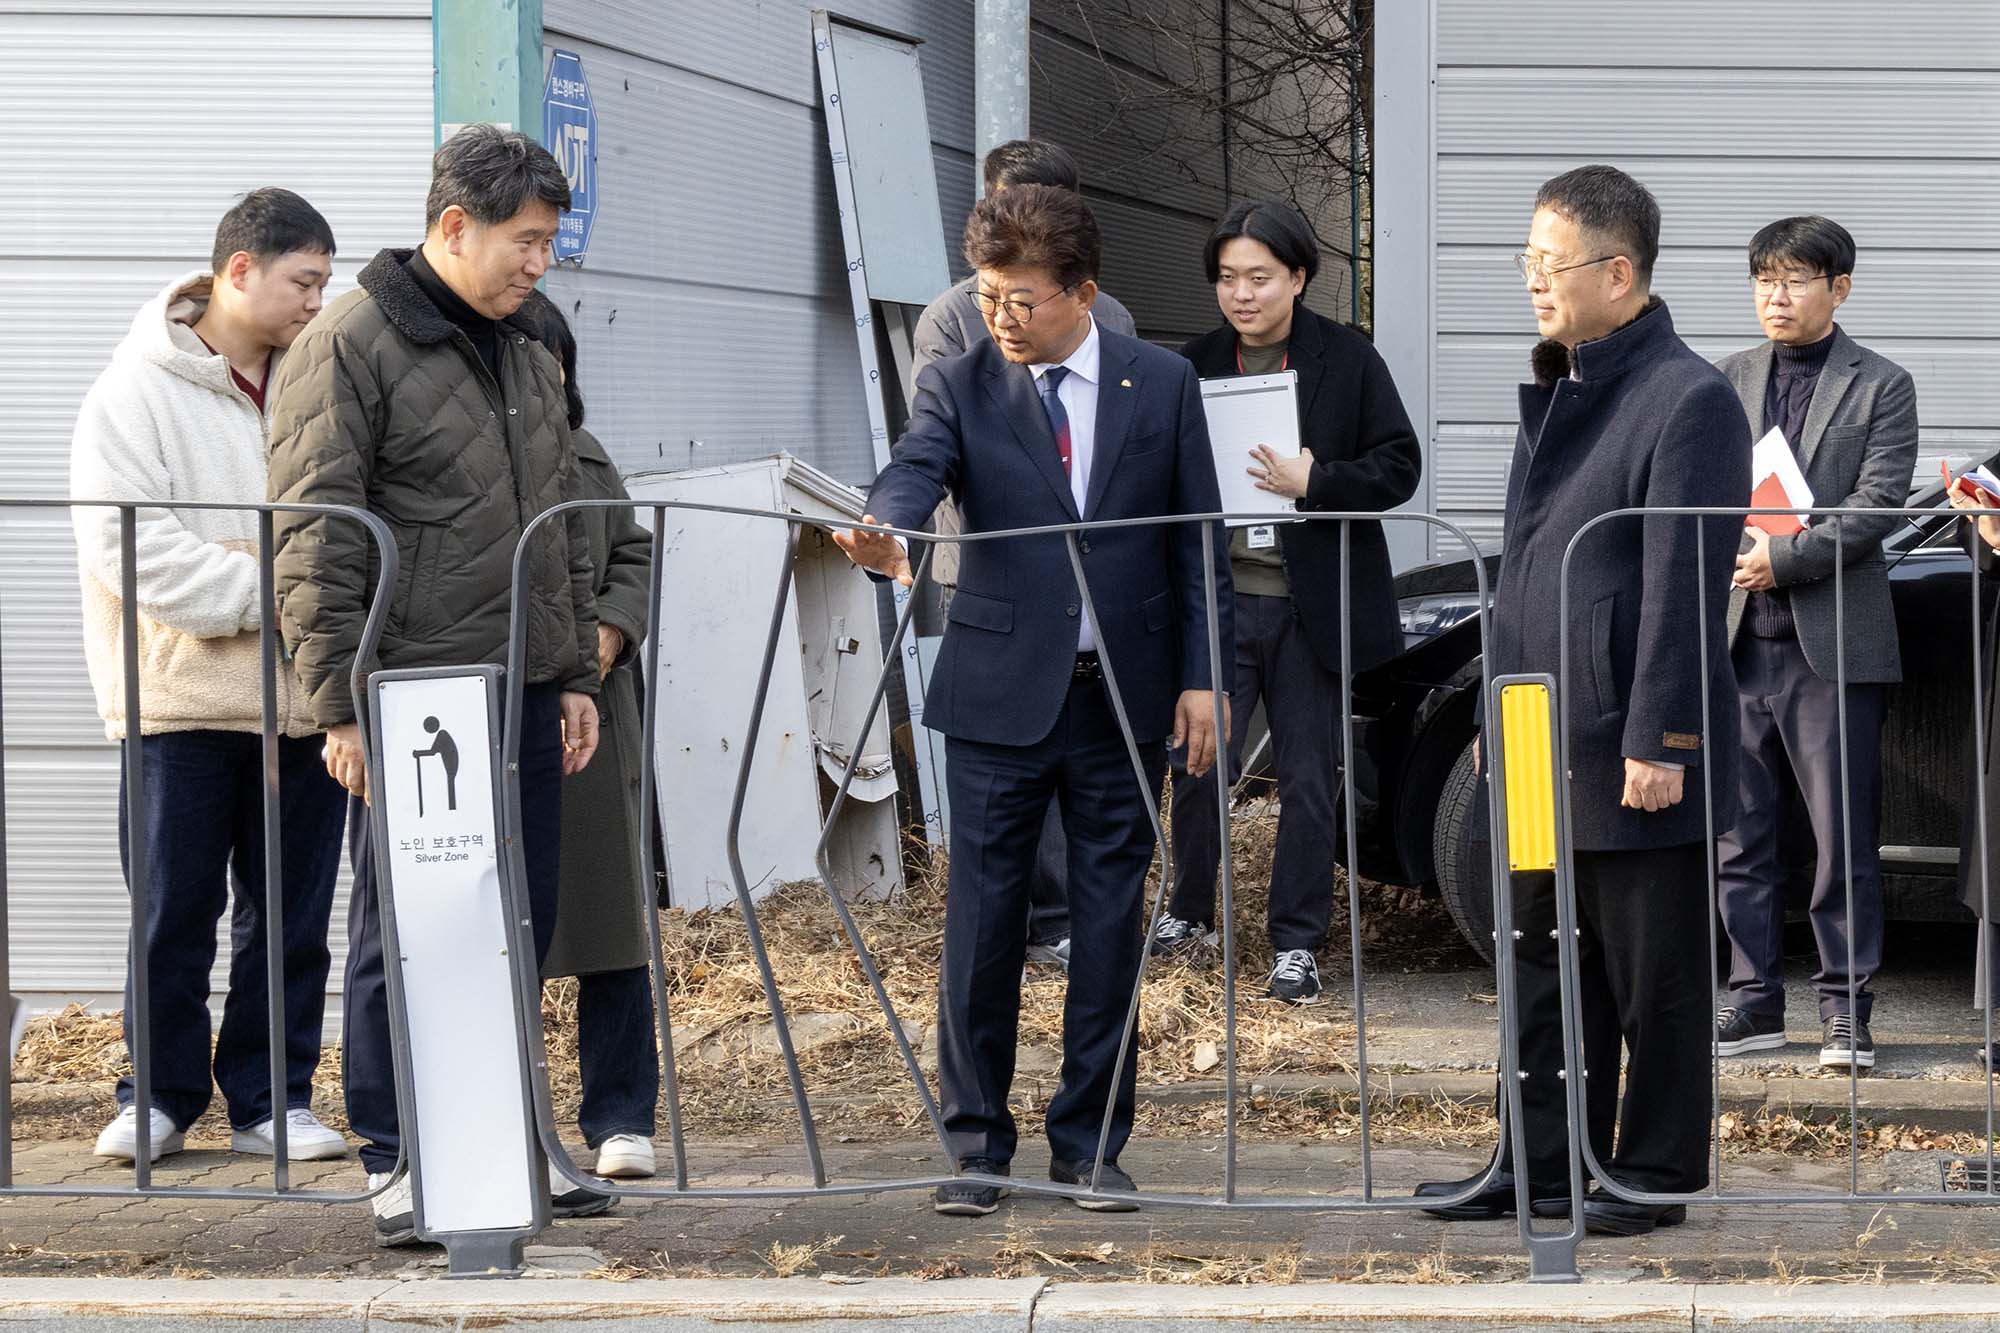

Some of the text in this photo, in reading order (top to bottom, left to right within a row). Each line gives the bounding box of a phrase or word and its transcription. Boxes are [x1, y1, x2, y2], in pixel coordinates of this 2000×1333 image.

[400, 834, 483, 851] 노인 보호구역
[415, 852, 469, 863] Silver Zone
